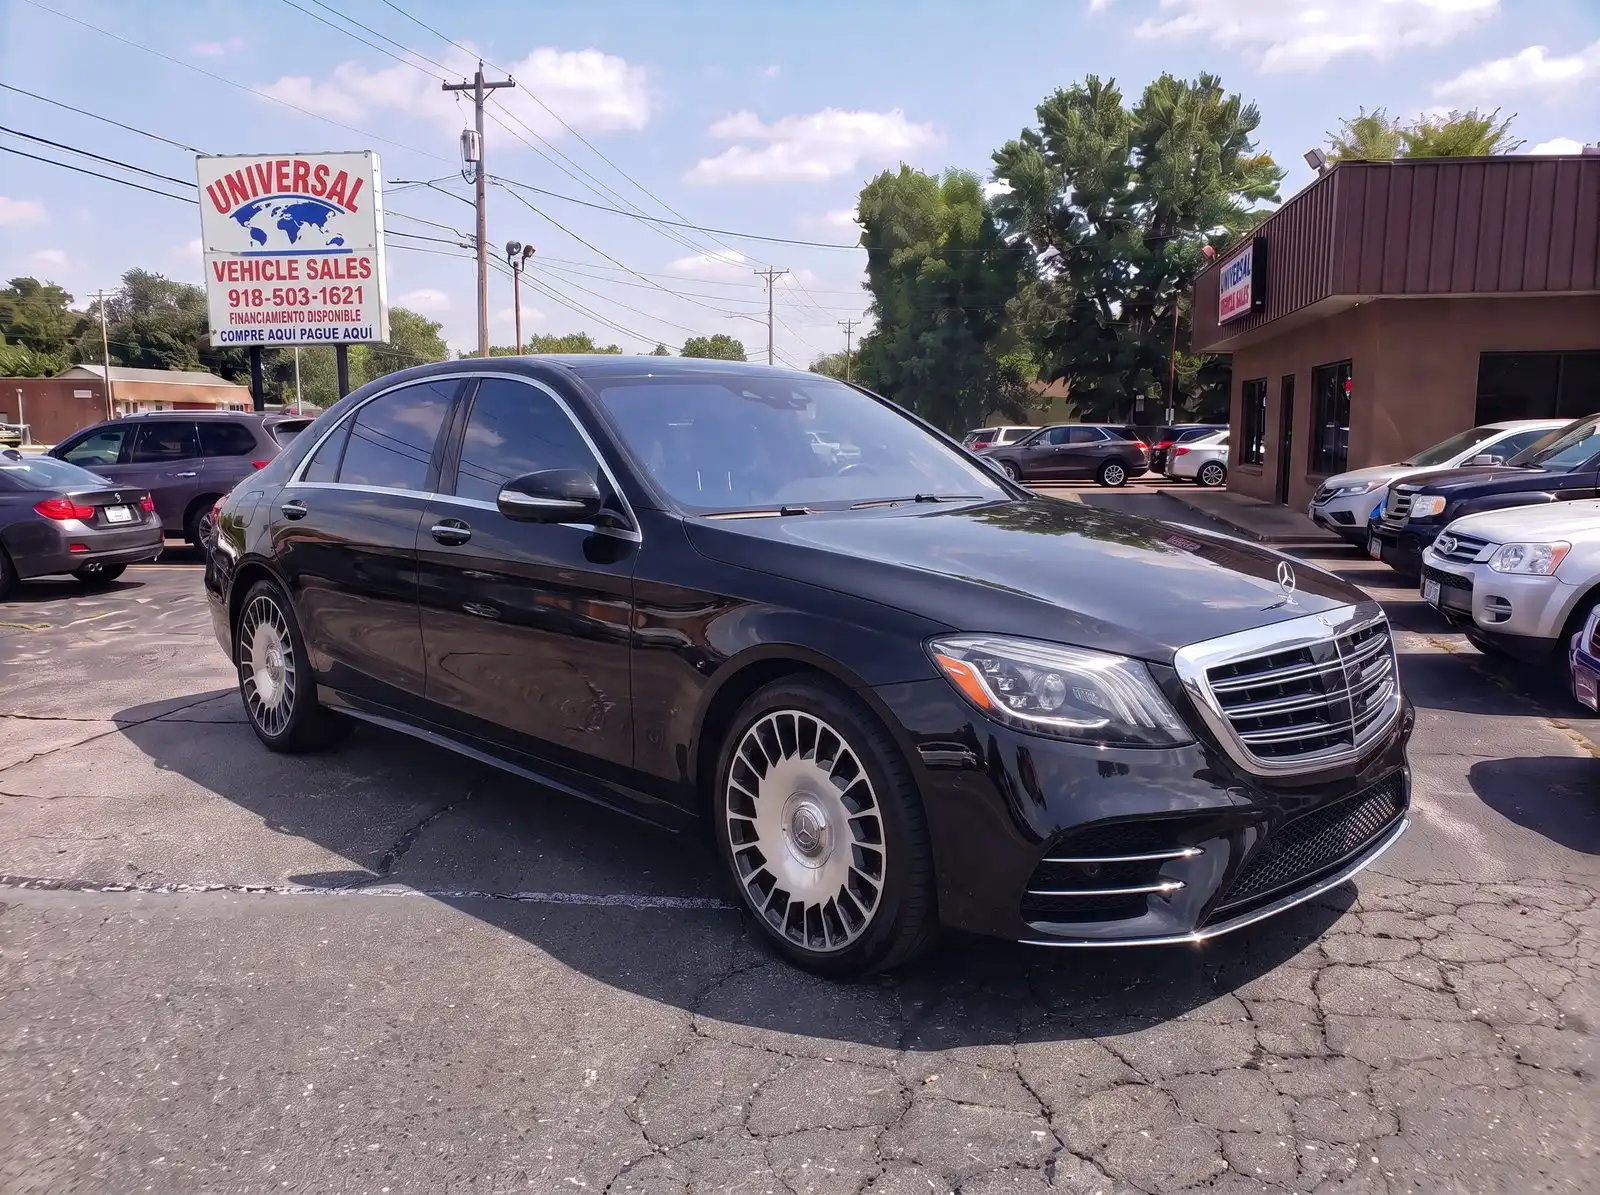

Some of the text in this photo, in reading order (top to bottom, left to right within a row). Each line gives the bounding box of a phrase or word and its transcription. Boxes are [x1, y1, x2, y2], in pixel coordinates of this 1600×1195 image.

[206, 160, 364, 214] UNIVERSAL
[212, 257, 372, 282] VEHICLE SALES
[228, 285, 363, 307] 918-503-1621
[229, 309, 361, 325] FINANCIAMIENTO DISPONIBLE
[220, 324, 373, 342] COMPRE AQUÍ PAGUE AQUÍ
